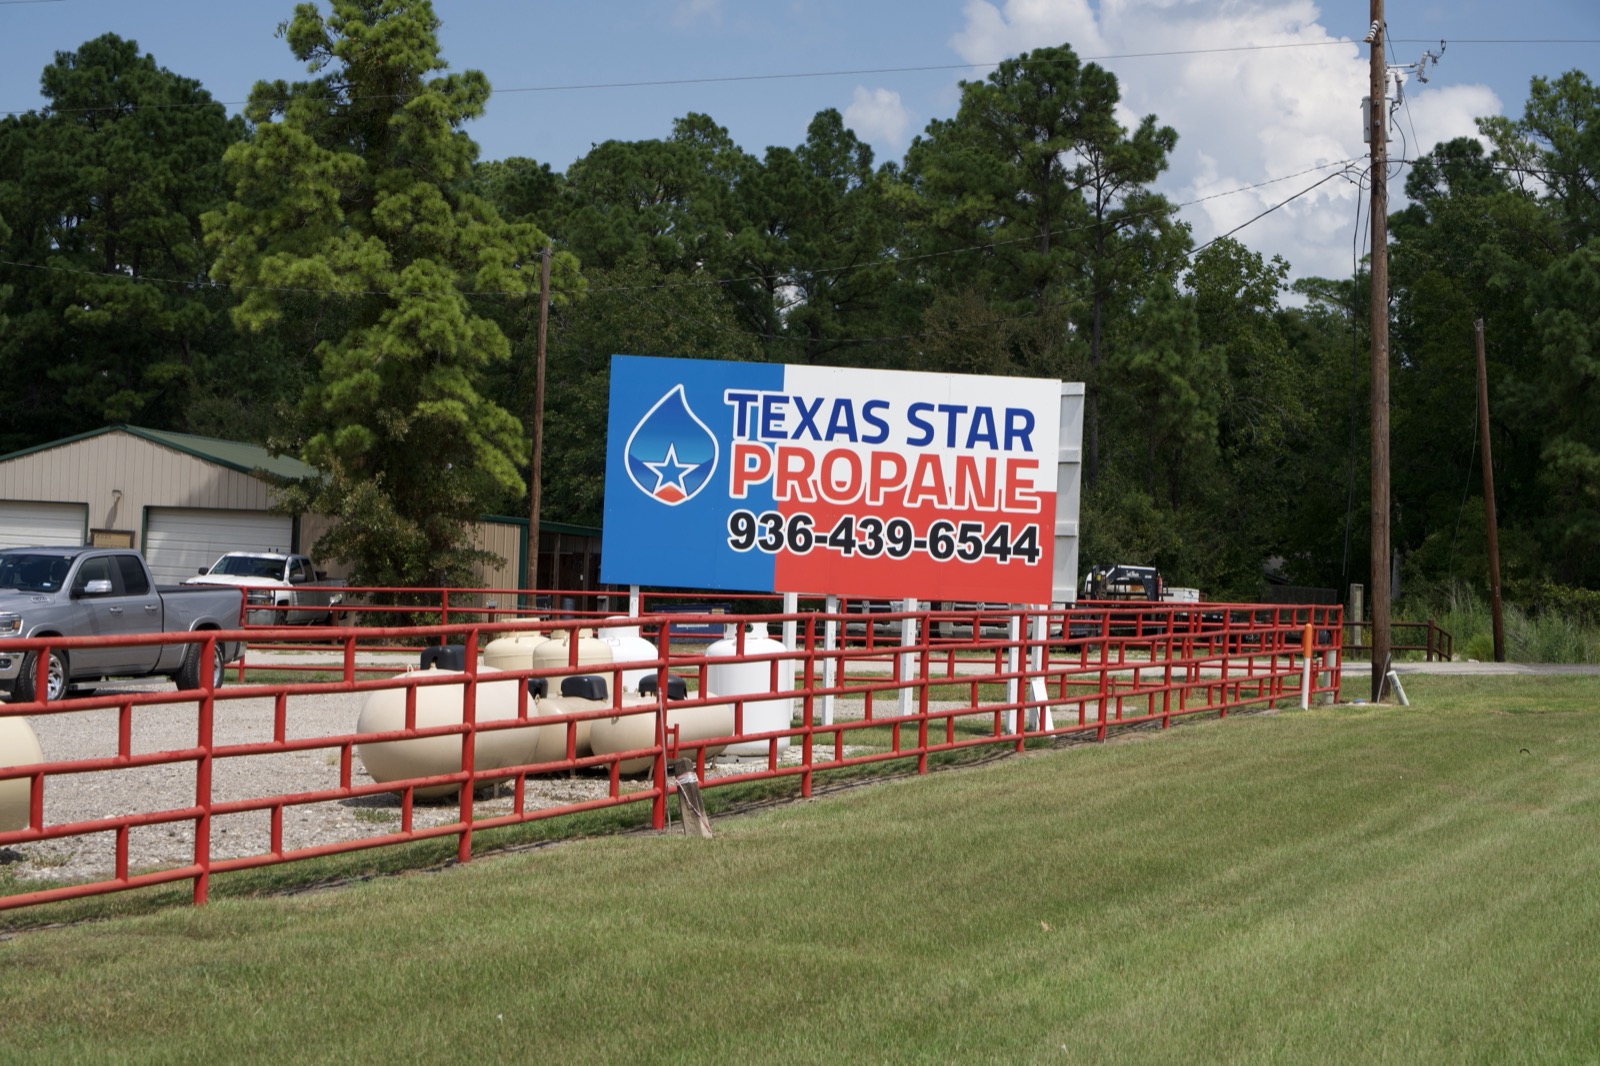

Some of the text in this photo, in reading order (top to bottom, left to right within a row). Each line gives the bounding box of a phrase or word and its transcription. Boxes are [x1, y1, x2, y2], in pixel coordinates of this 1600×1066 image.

[727, 392, 1036, 452] TEXAS STAR
[733, 443, 1040, 510] PROPANE
[729, 511, 1040, 563] 936-439-6544
